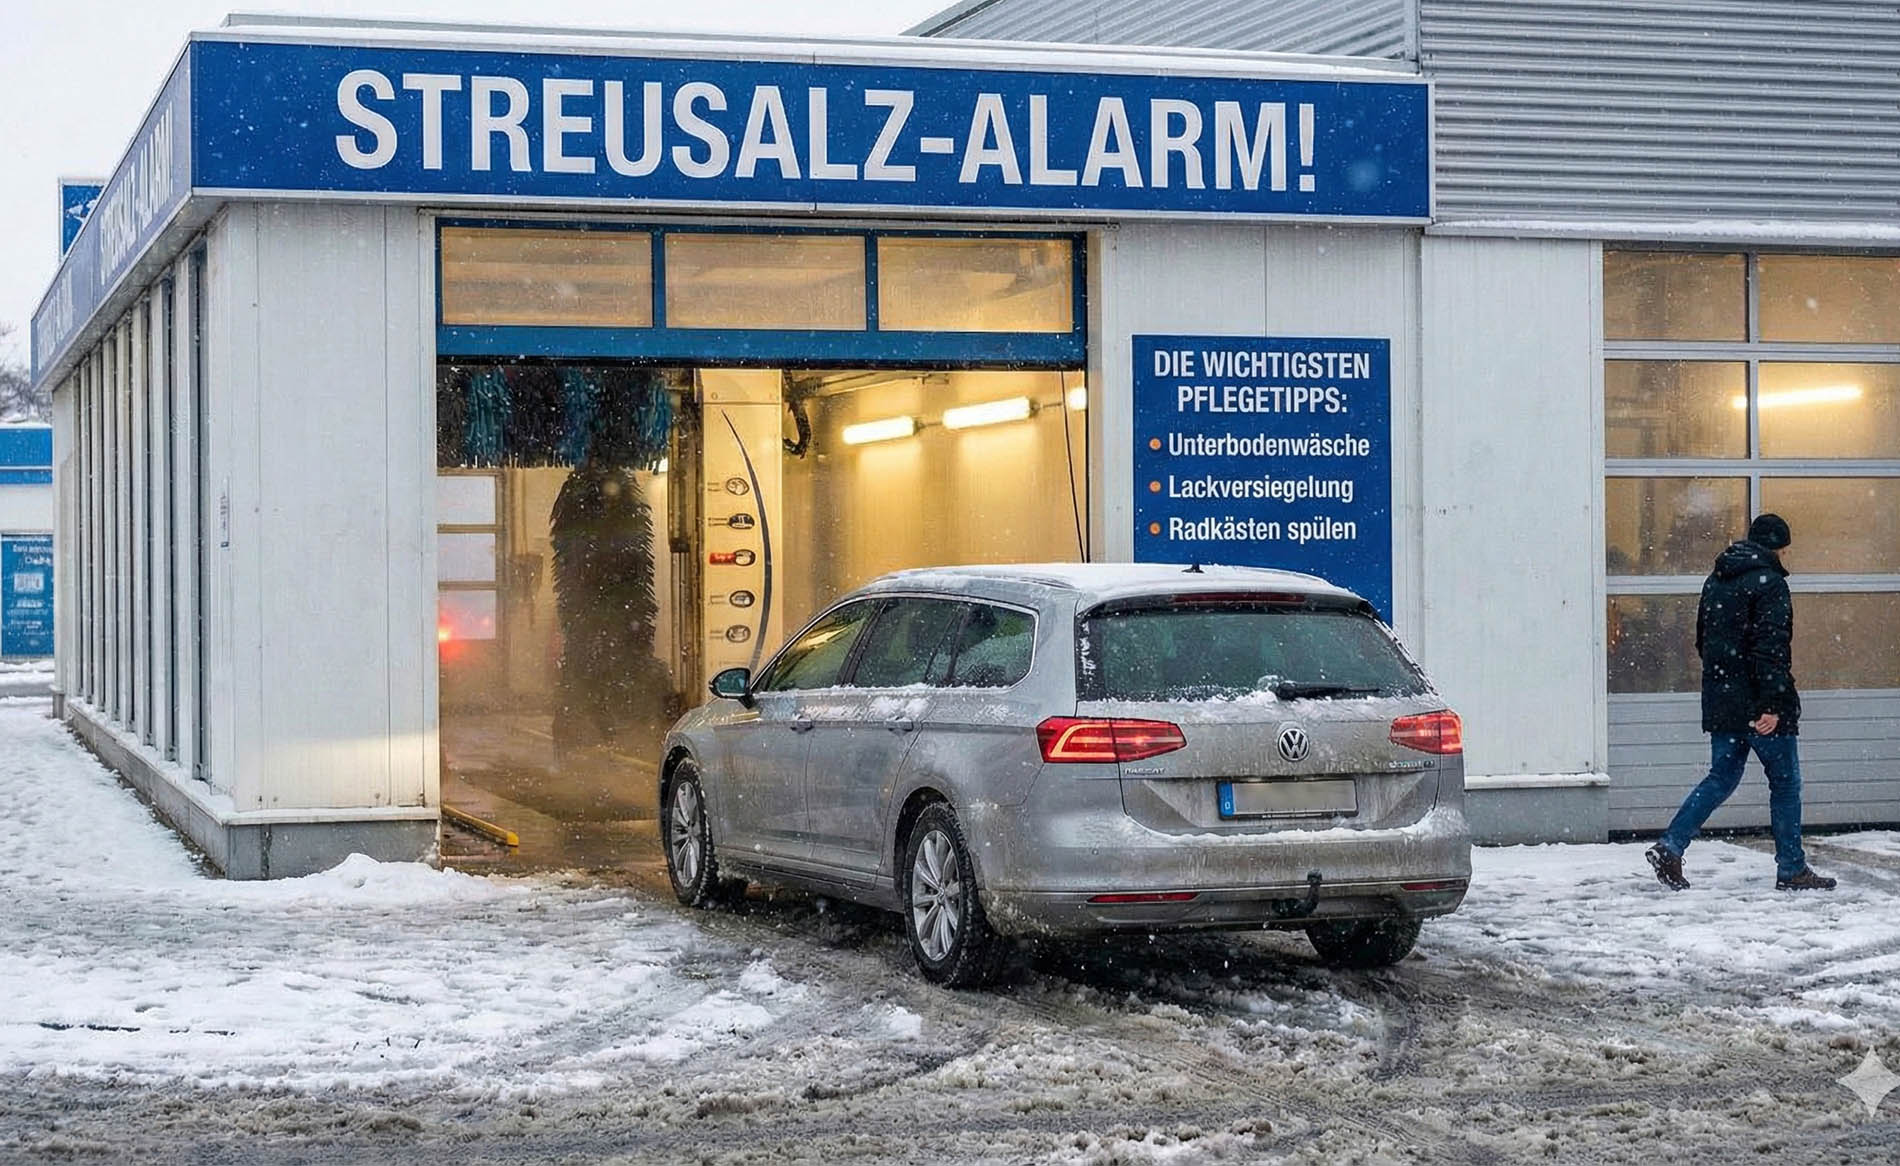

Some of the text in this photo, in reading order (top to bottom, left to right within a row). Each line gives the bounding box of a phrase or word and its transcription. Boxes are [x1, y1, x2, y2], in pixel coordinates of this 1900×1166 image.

[335, 68, 1317, 193] STREUSALZ-ALARM!
[1154, 350, 1370, 380] DIE WICHTIGSTEN
[1177, 386, 1348, 414] PFLEGETIPPS:
[1168, 432, 1371, 457] Unterbodenwäsche
[1168, 475, 1354, 503] Lackversiegelung
[1169, 517, 1357, 545] Radkästen spülen
